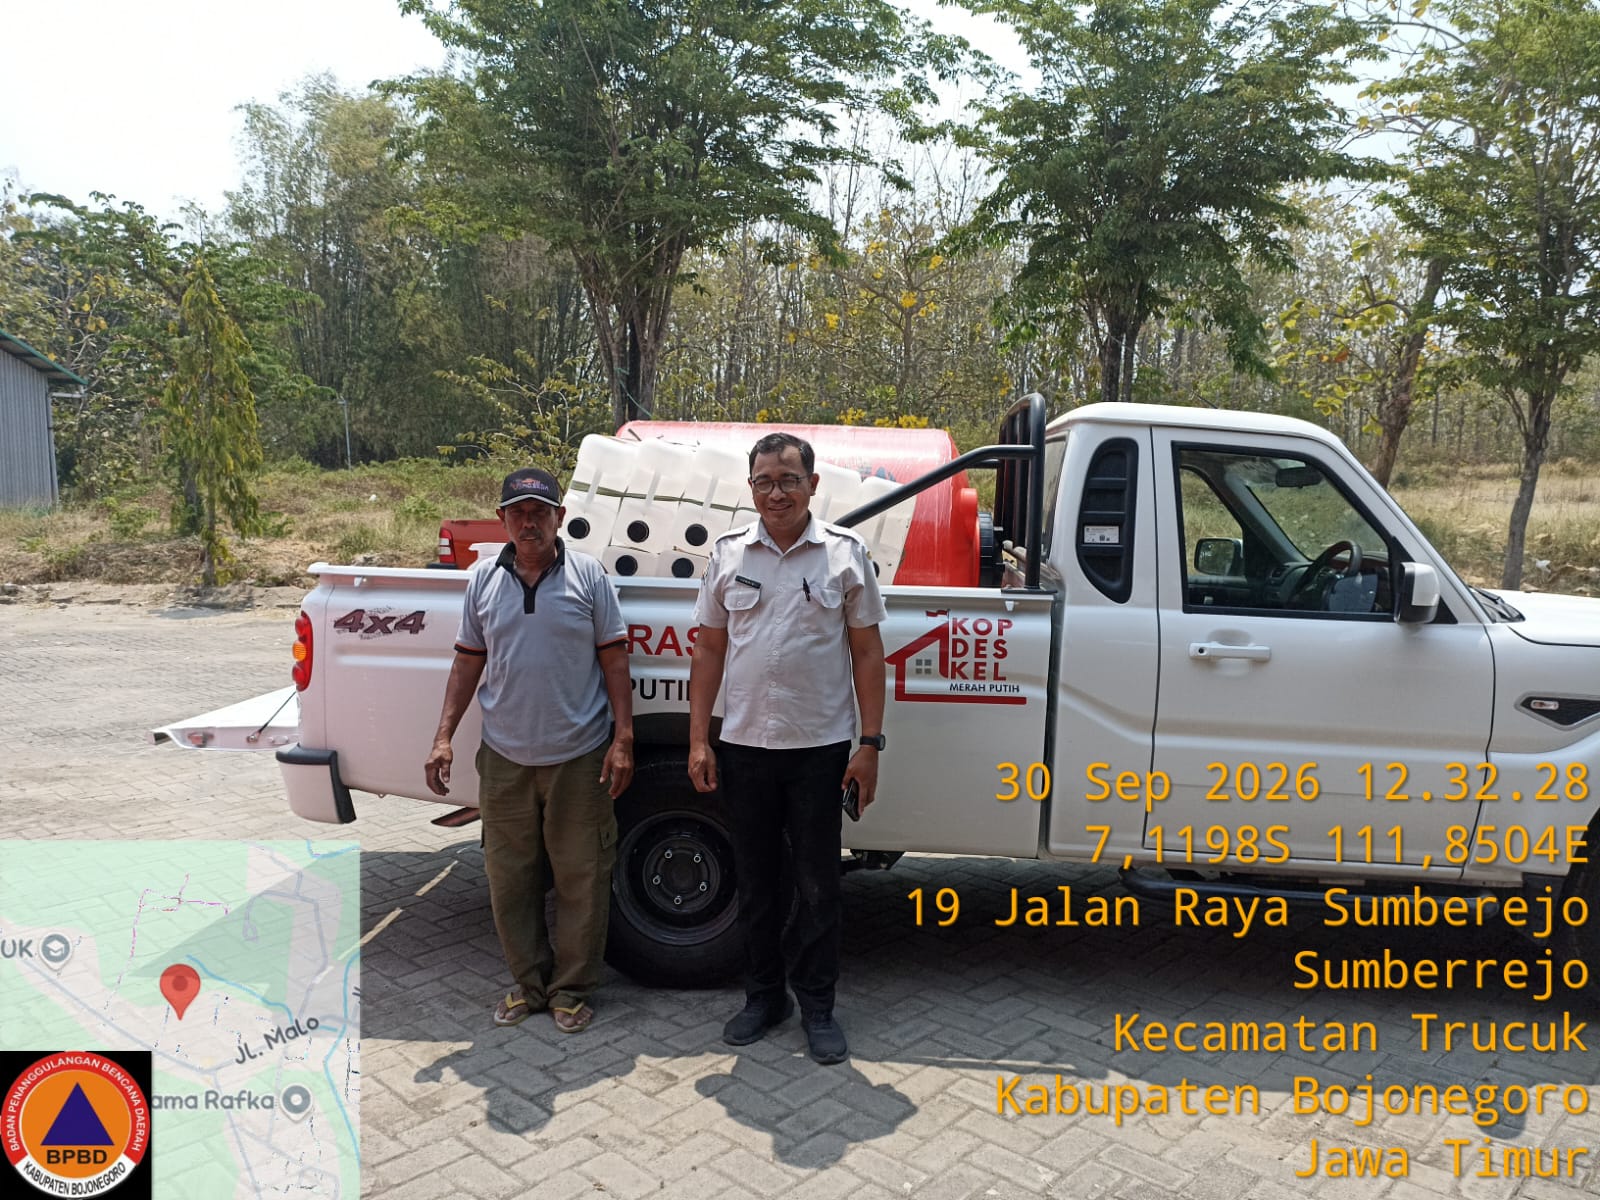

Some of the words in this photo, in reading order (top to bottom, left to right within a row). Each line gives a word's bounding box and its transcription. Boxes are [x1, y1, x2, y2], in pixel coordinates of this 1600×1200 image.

[333, 608, 426, 635] 4x4
[952, 617, 1013, 637] KOP
[951, 638, 1008, 660] DES
[950, 661, 1007, 681] KEL
[949, 682, 986, 692] MERAH
[989, 684, 1020, 693] PUTIH
